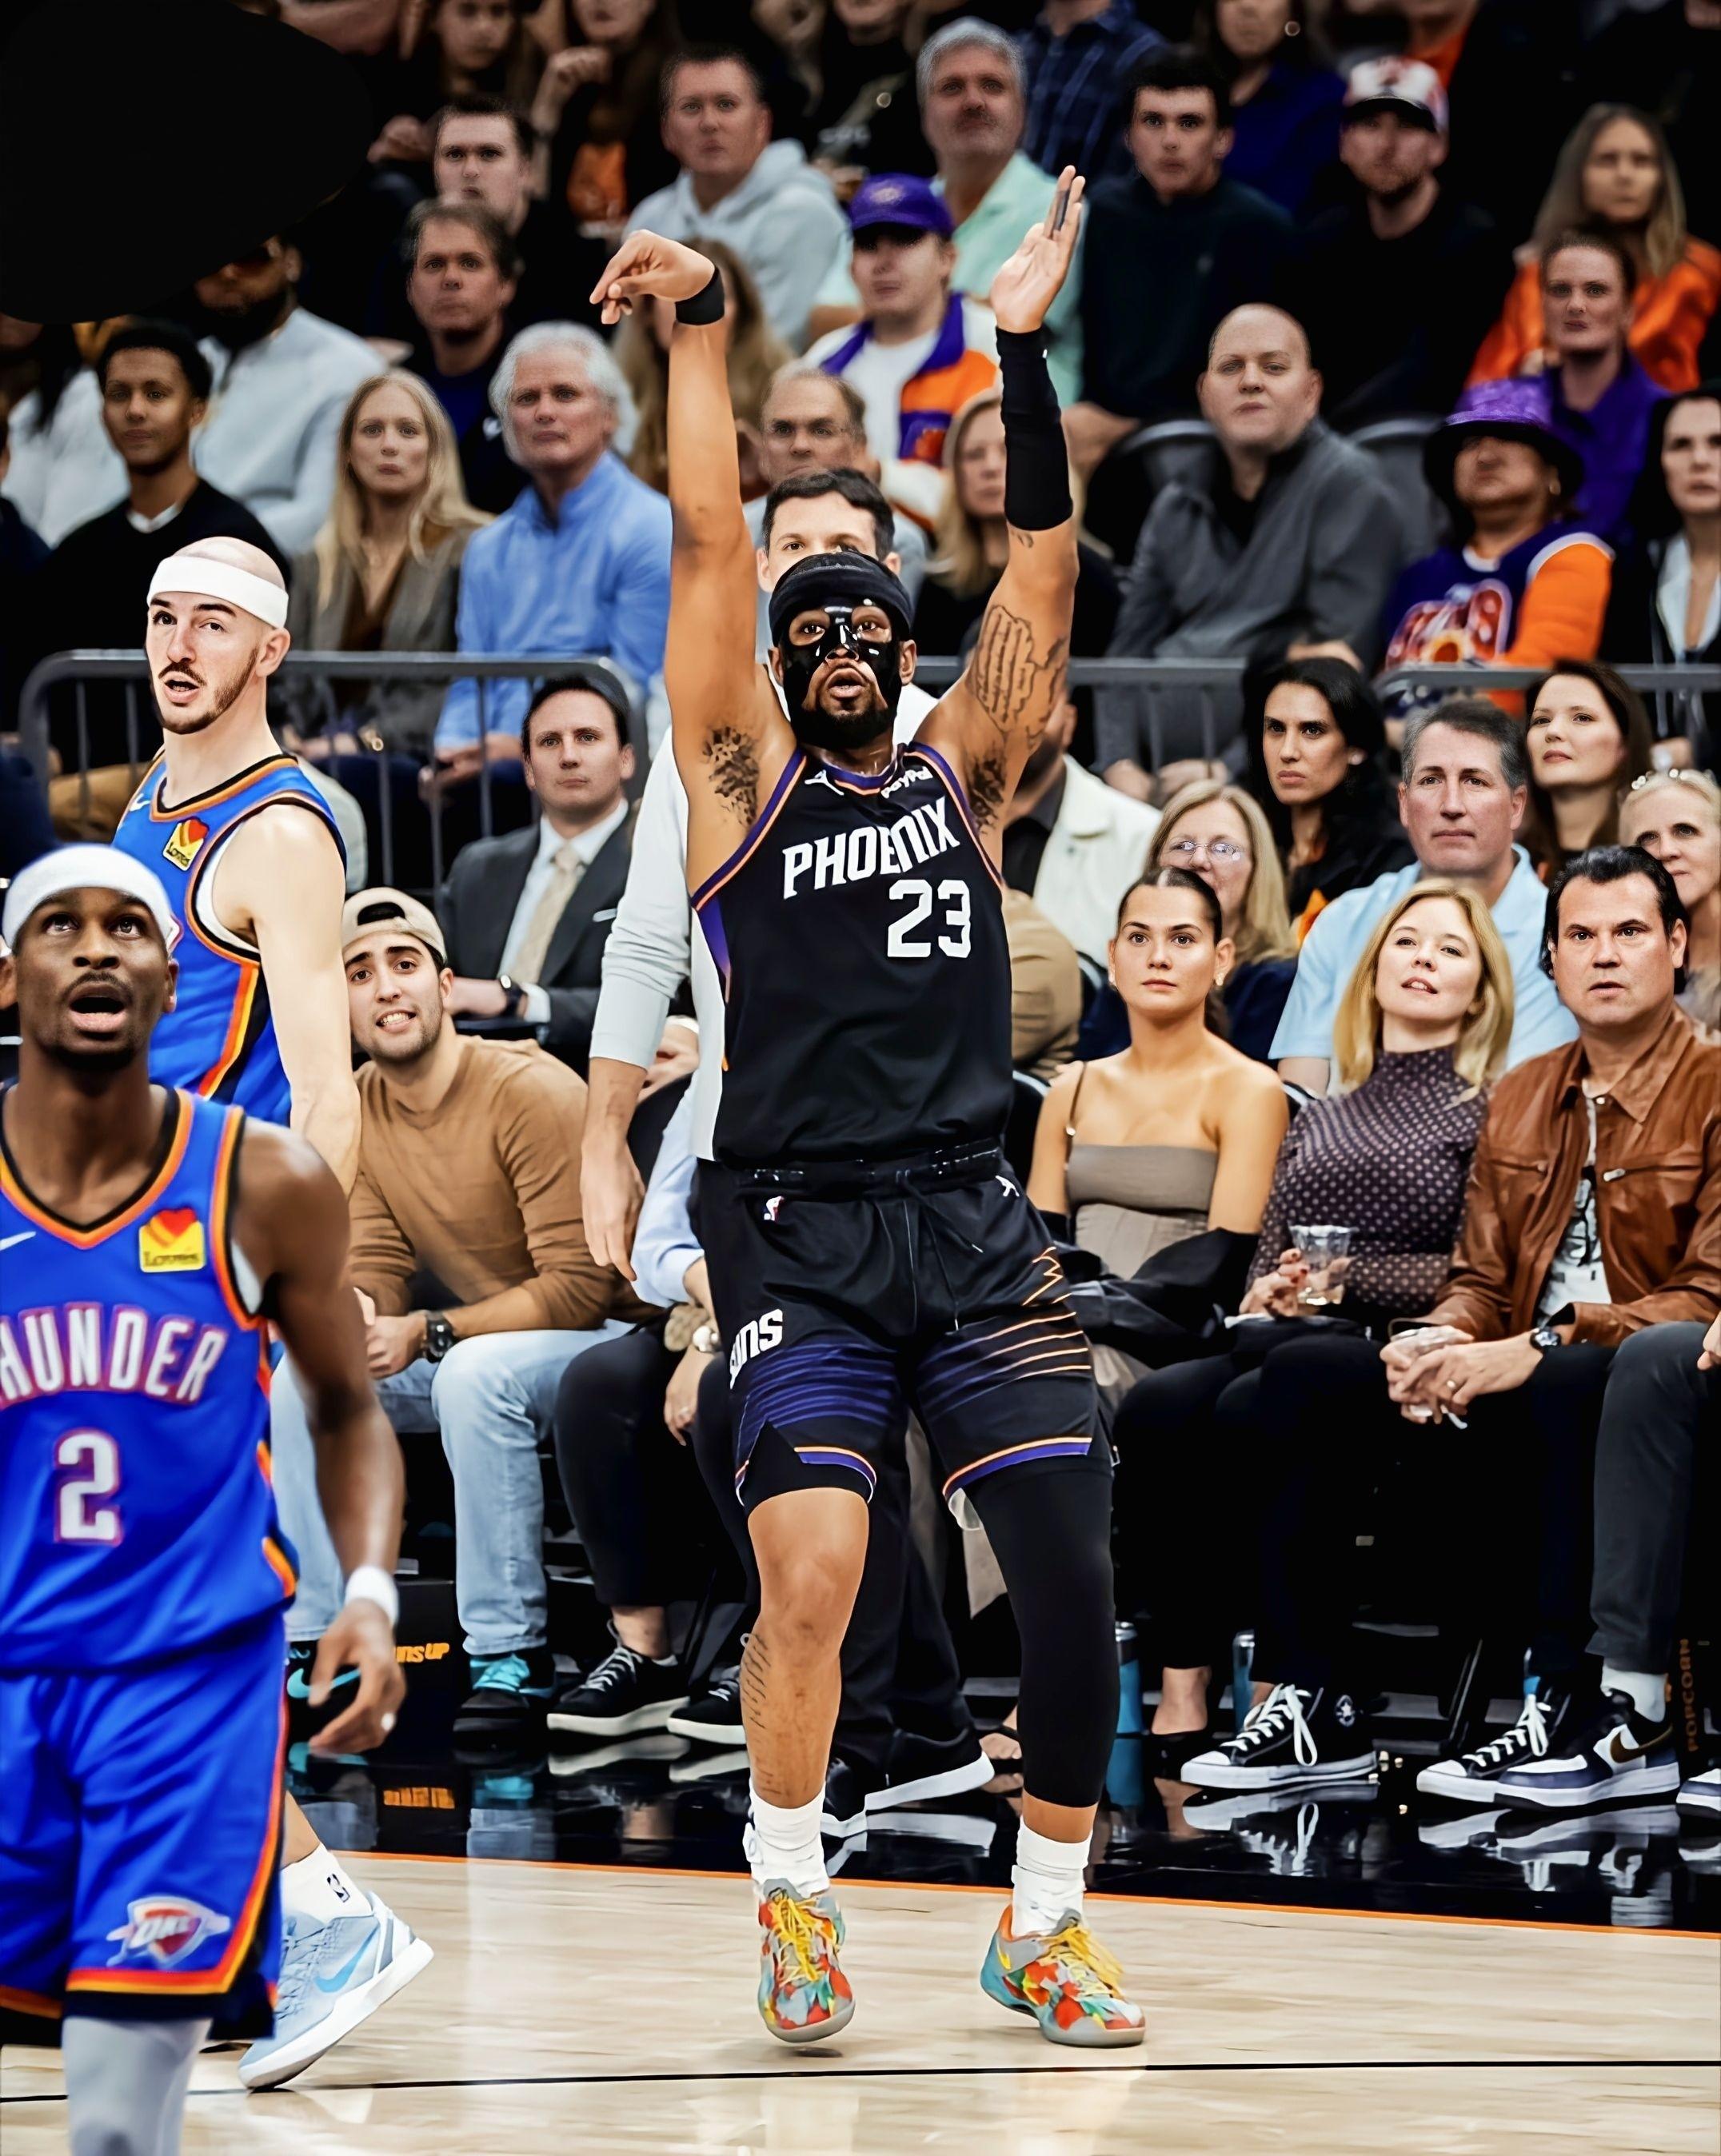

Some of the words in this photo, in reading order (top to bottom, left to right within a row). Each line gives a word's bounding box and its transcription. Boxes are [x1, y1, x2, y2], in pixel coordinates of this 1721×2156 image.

[782, 796, 960, 900] PHOENIX
[887, 879, 972, 959] 23
[0, 1303, 228, 1406] HUNDER
[54, 1427, 123, 1546] 2
[425, 1643, 450, 1660] UP
[1679, 1639, 1699, 1752] POPCORN
